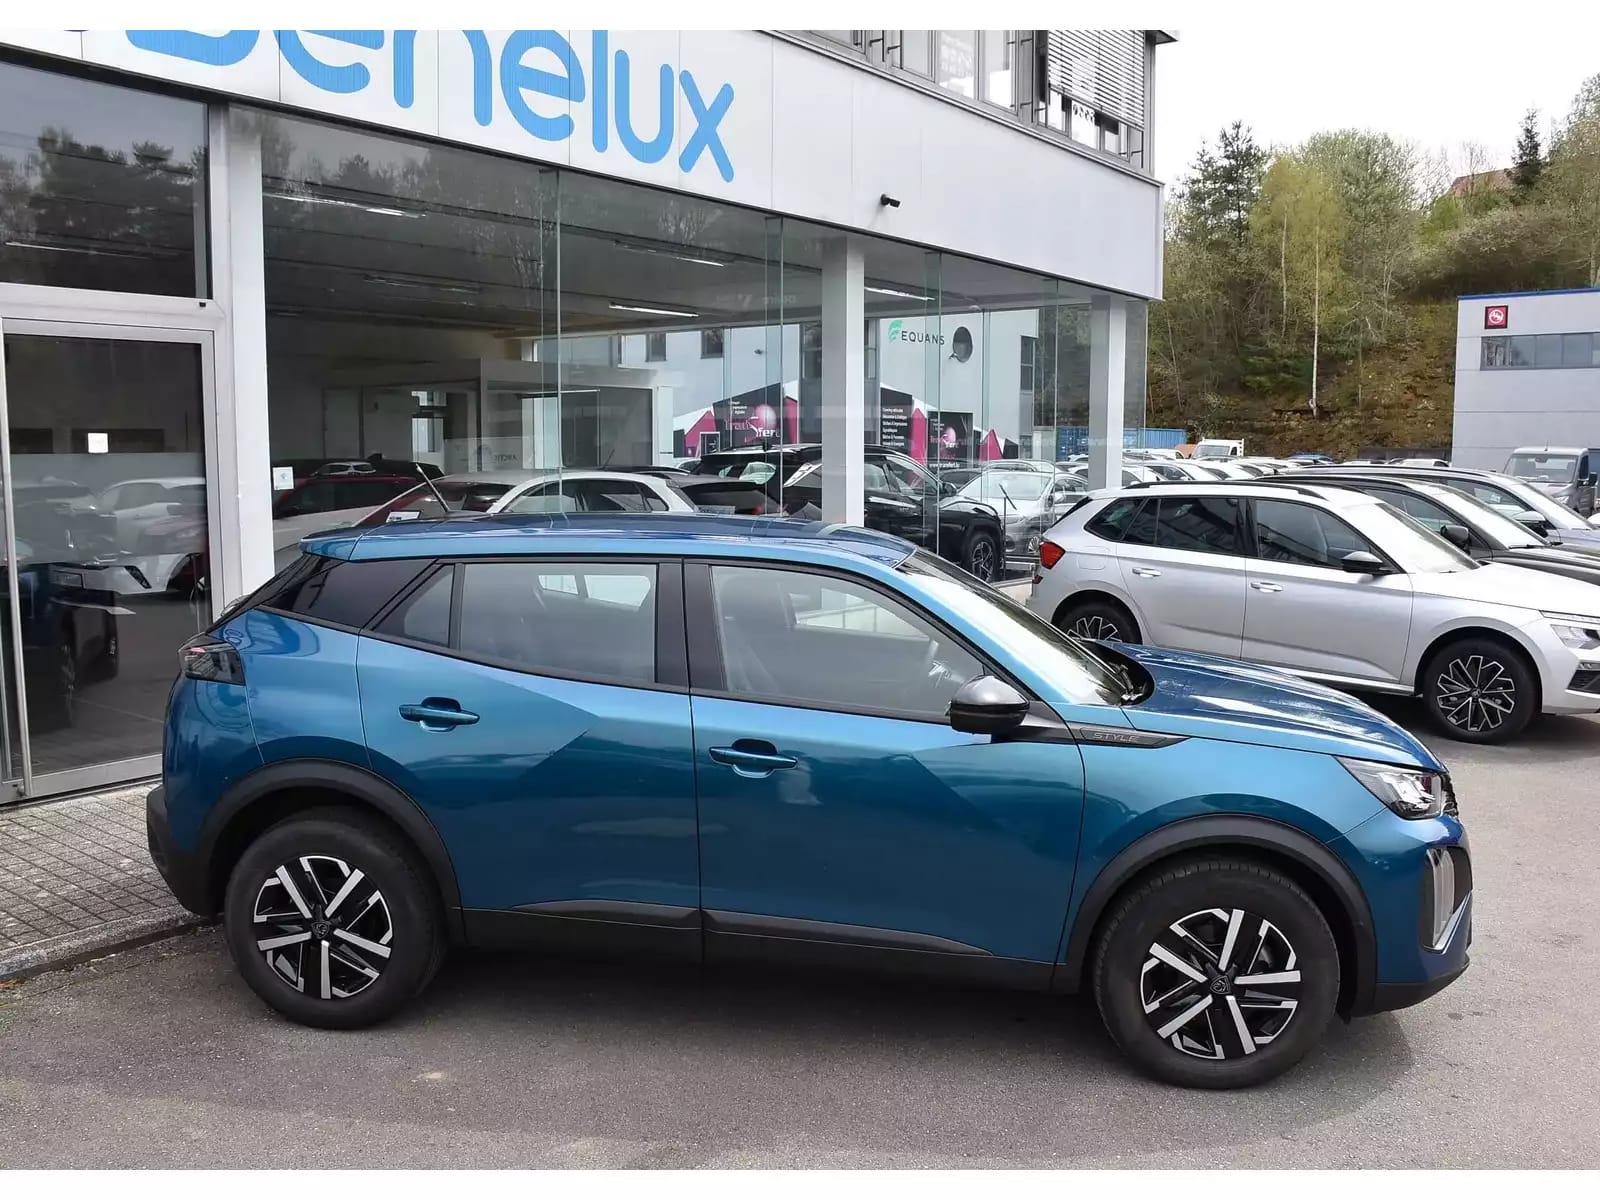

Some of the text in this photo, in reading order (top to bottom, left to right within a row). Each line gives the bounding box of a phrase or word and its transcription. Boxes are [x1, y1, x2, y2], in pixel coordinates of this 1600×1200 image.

[126, 30, 735, 182] enelux
[901, 330, 945, 346] EQUANS
[1093, 732, 1140, 743] STYLE
